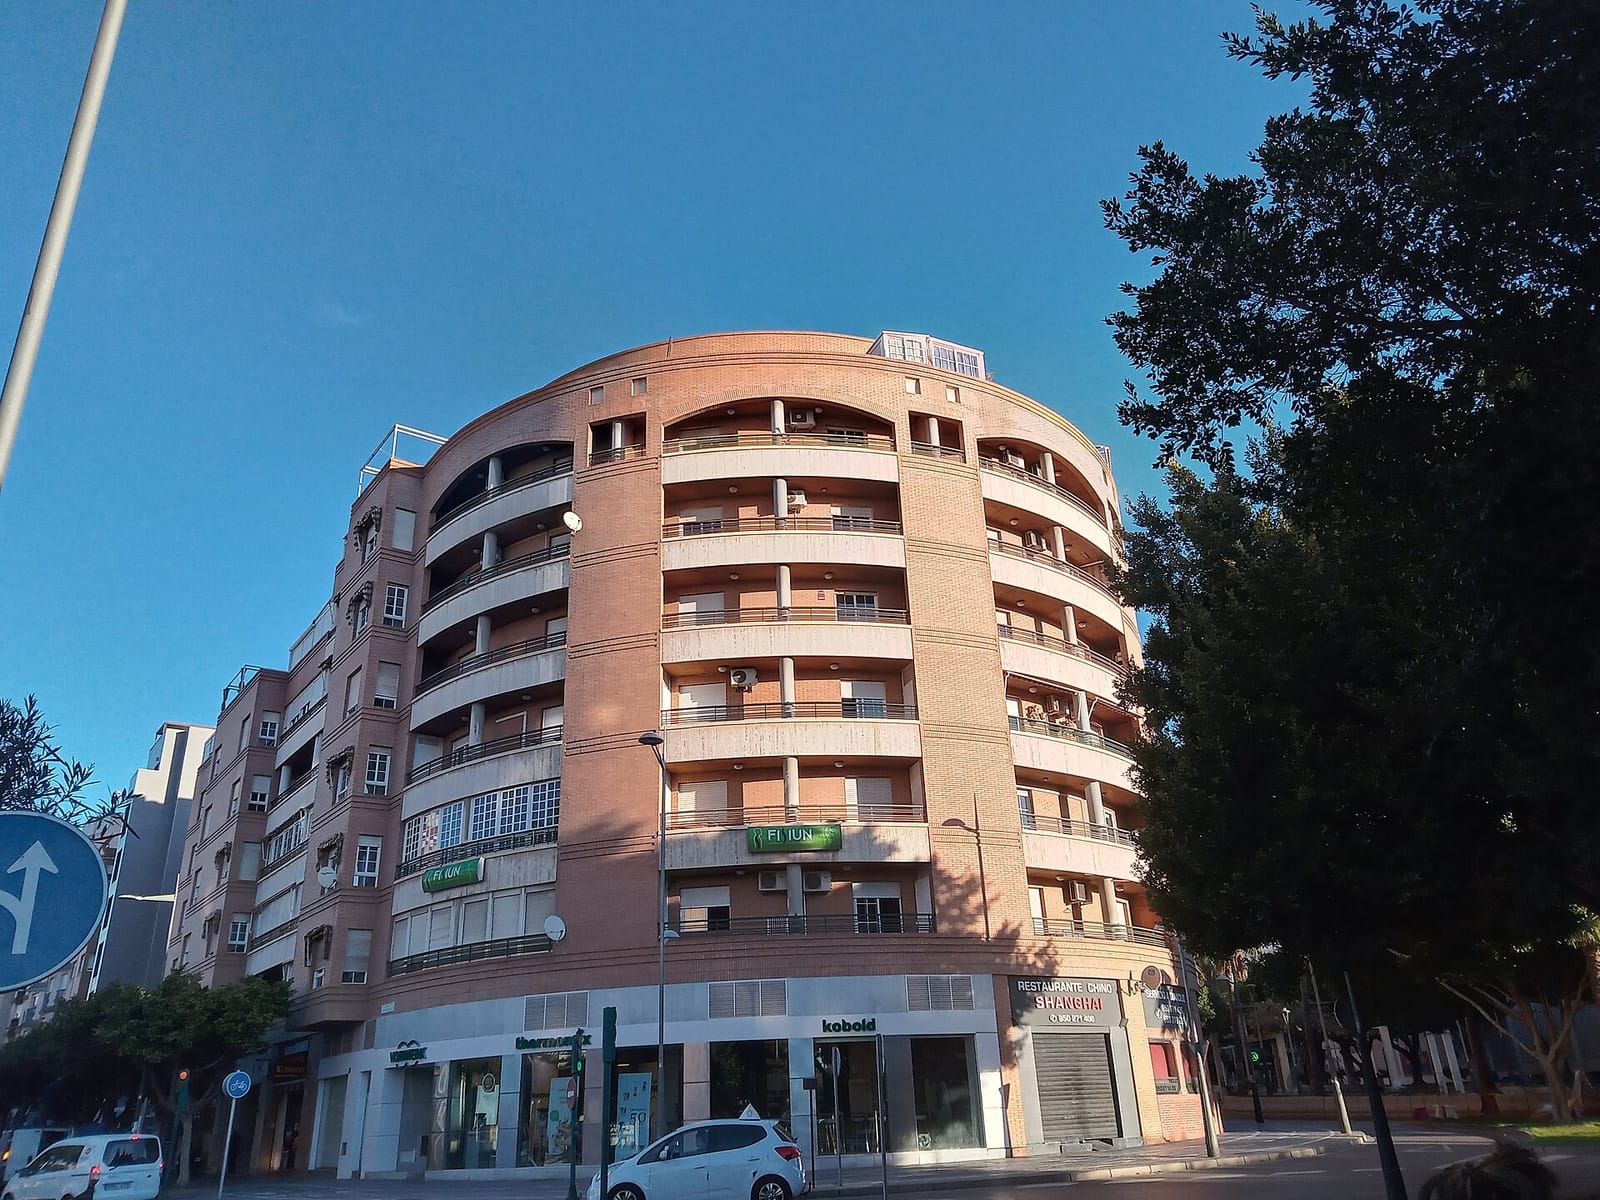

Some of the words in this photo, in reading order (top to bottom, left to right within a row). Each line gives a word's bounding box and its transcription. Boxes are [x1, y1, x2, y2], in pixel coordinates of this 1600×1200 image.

[1017, 980, 1083, 993] RESTAURANTE
[1087, 982, 1113, 994] CHINO
[1035, 996, 1103, 1010] SHANGHAI
[822, 1018, 876, 1032] kobold
